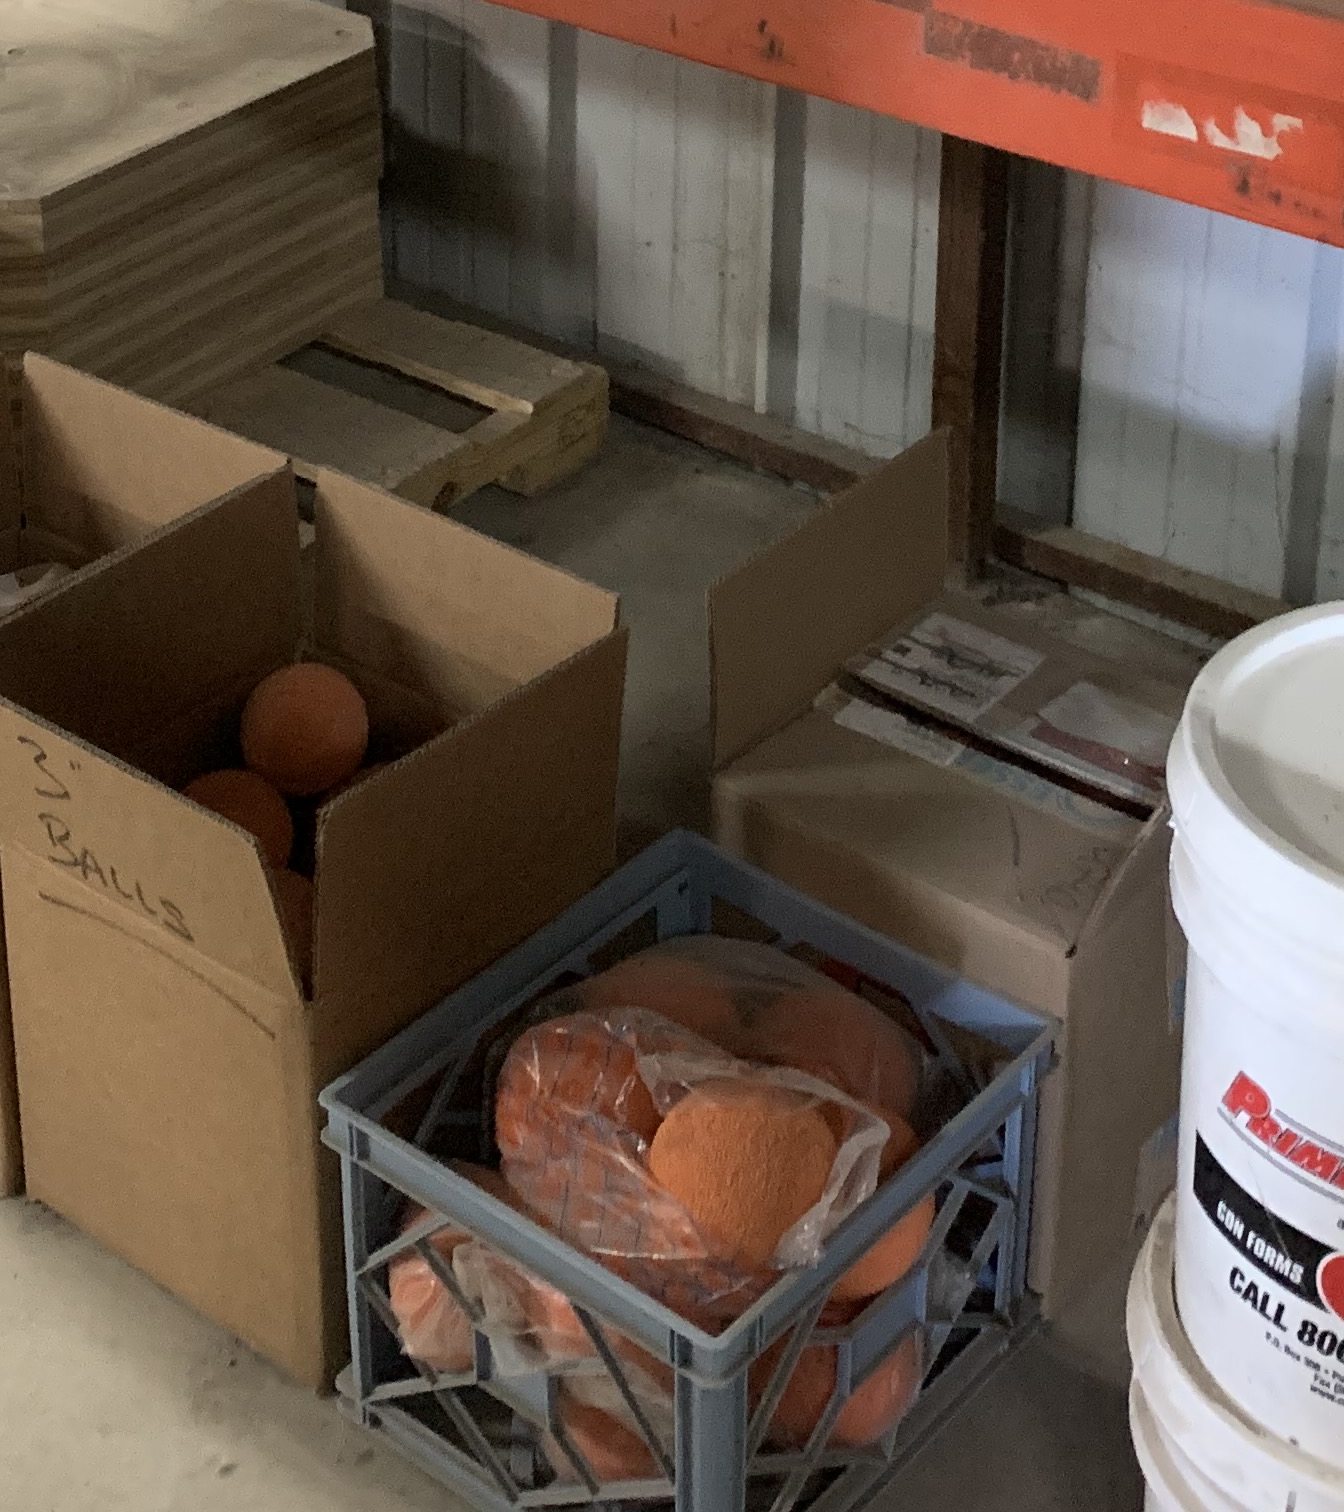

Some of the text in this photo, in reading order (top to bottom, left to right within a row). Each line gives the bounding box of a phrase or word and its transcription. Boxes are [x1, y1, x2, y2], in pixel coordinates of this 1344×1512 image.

[36, 812, 196, 945] BALLS
[1216, 1199, 1305, 1286] CON FORMS
[1336, 1216, 1344, 1232] a
[1228, 1265, 1289, 1333] CALL
